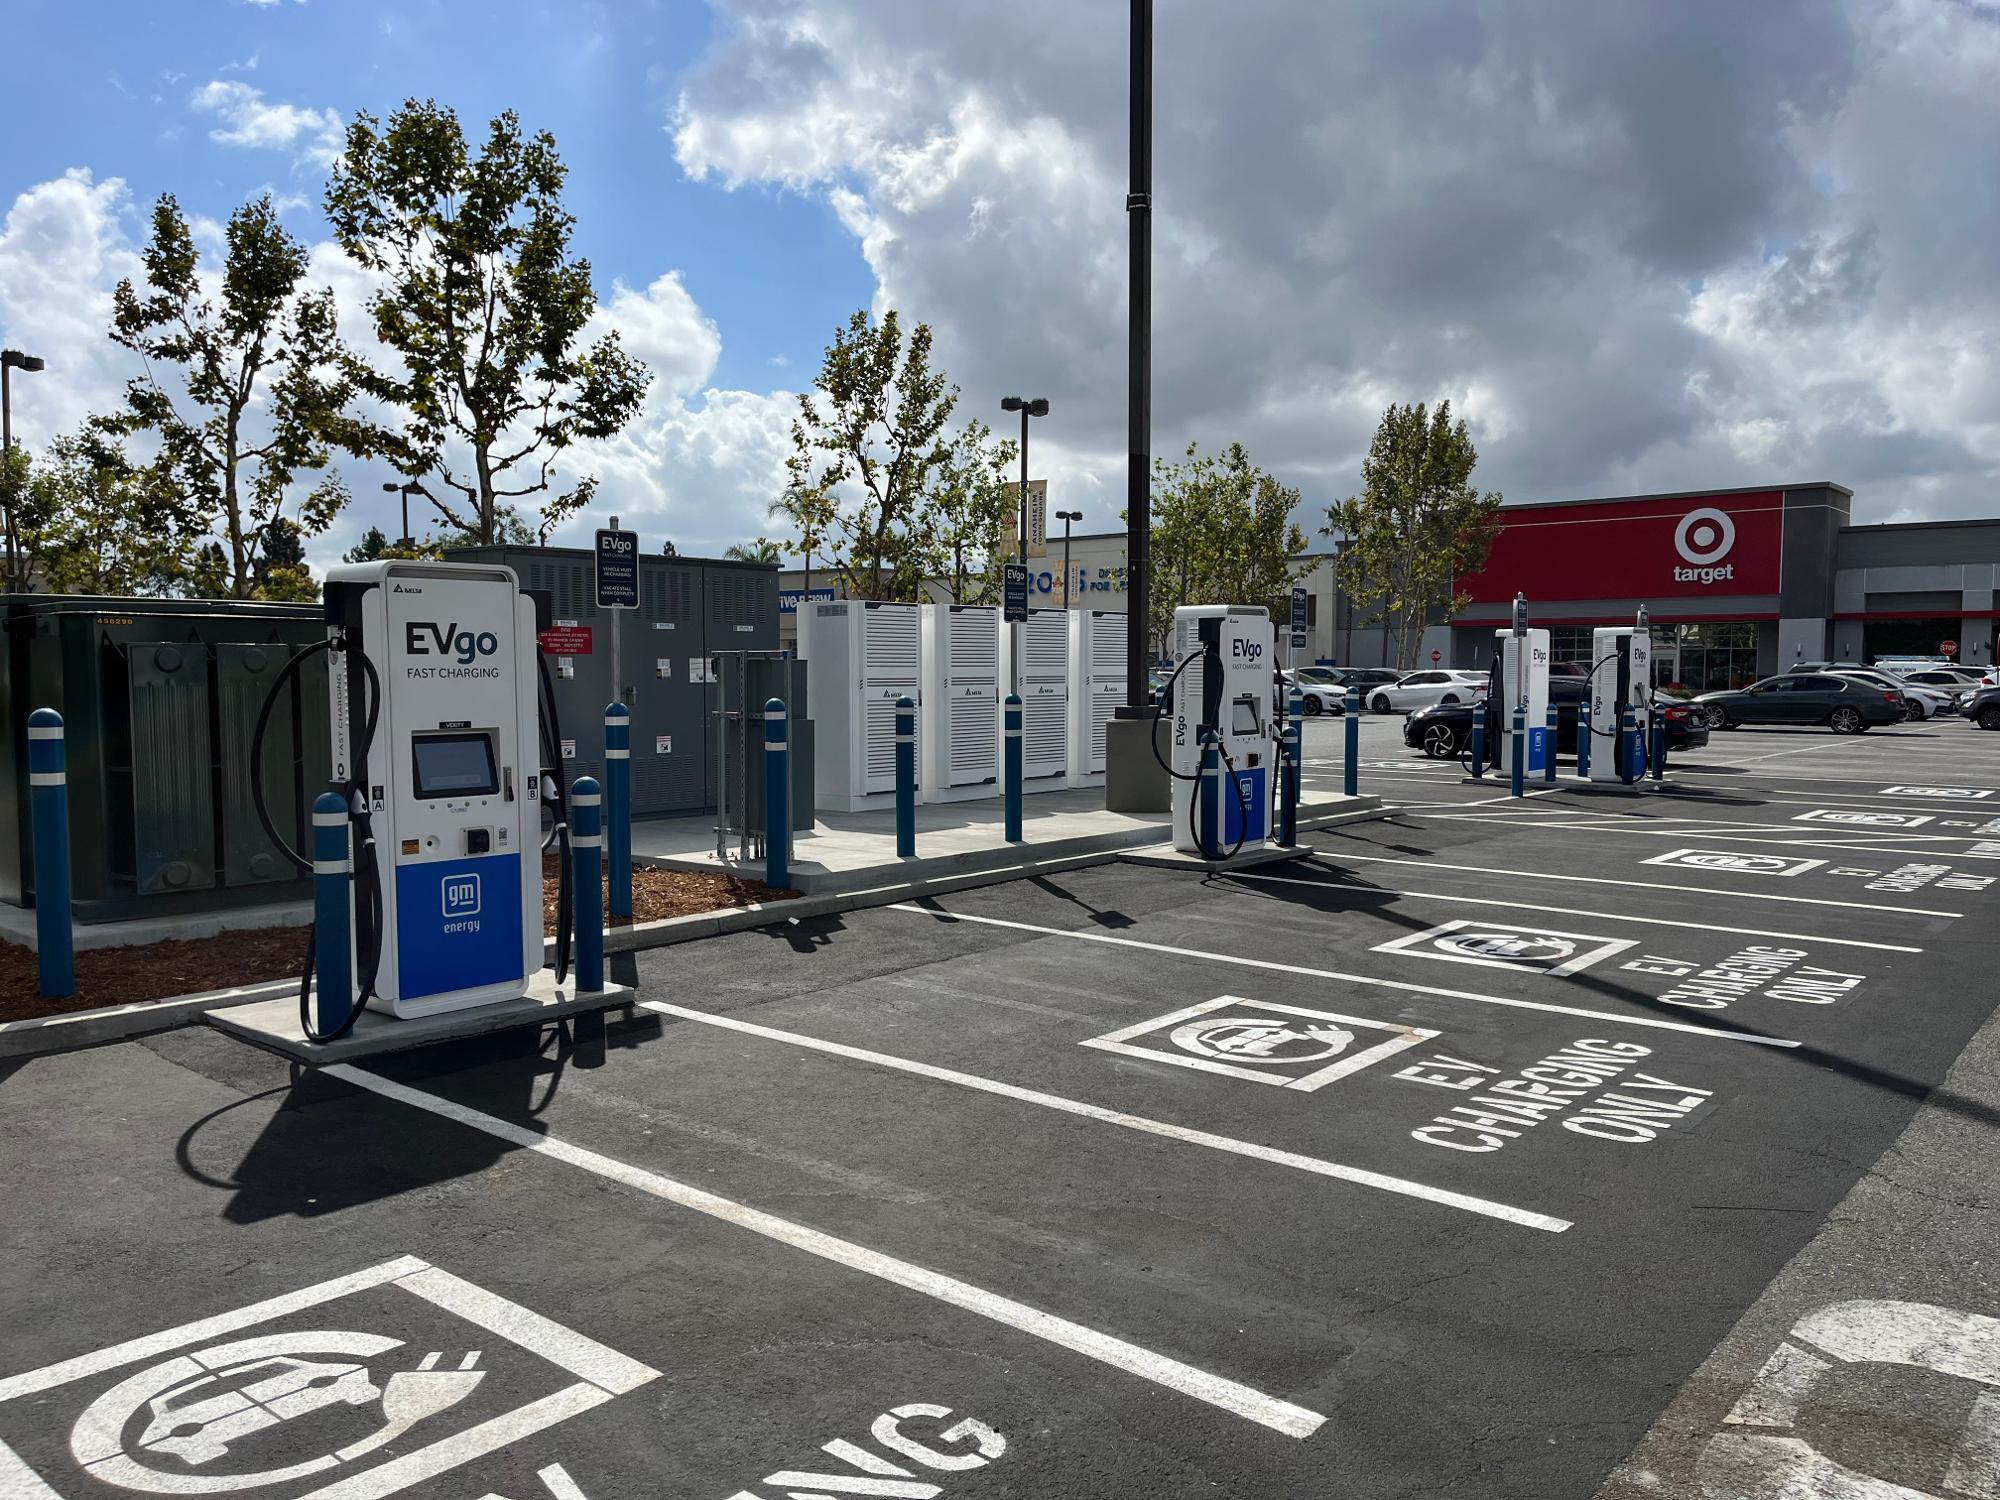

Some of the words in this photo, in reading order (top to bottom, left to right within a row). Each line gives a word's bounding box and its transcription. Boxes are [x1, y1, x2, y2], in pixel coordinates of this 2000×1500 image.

[602, 537, 632, 553] EVgo
[1007, 569, 1025, 581] EVgo
[1673, 564, 1734, 584] target
[1090, 582, 1110, 592] FOR
[779, 595, 797, 609] ive
[406, 622, 498, 665] EVgo
[1233, 639, 1262, 662] EVgo
[1533, 649, 1547, 664] EVgo
[1635, 648, 1646, 663] EVgo
[407, 668, 436, 679] FAST
[439, 667, 499, 679] CHARGING
[336, 673, 344, 729] CHARGING
[1594, 696, 1602, 716] EVgo
[1176, 715, 1187, 746] EVgo
[530, 790, 536, 798] B
[374, 800, 382, 810] A
[449, 883, 474, 907] gm
[444, 920, 480, 933] energy
[1619, 955, 1700, 976] EV
[1656, 946, 1808, 1009] CHARGING
[1763, 966, 1866, 1005] ONLY
[1391, 1054, 1501, 1090] EV
[1411, 1038, 1652, 1152] CHARGING
[1562, 1073, 1714, 1143] ONLY
